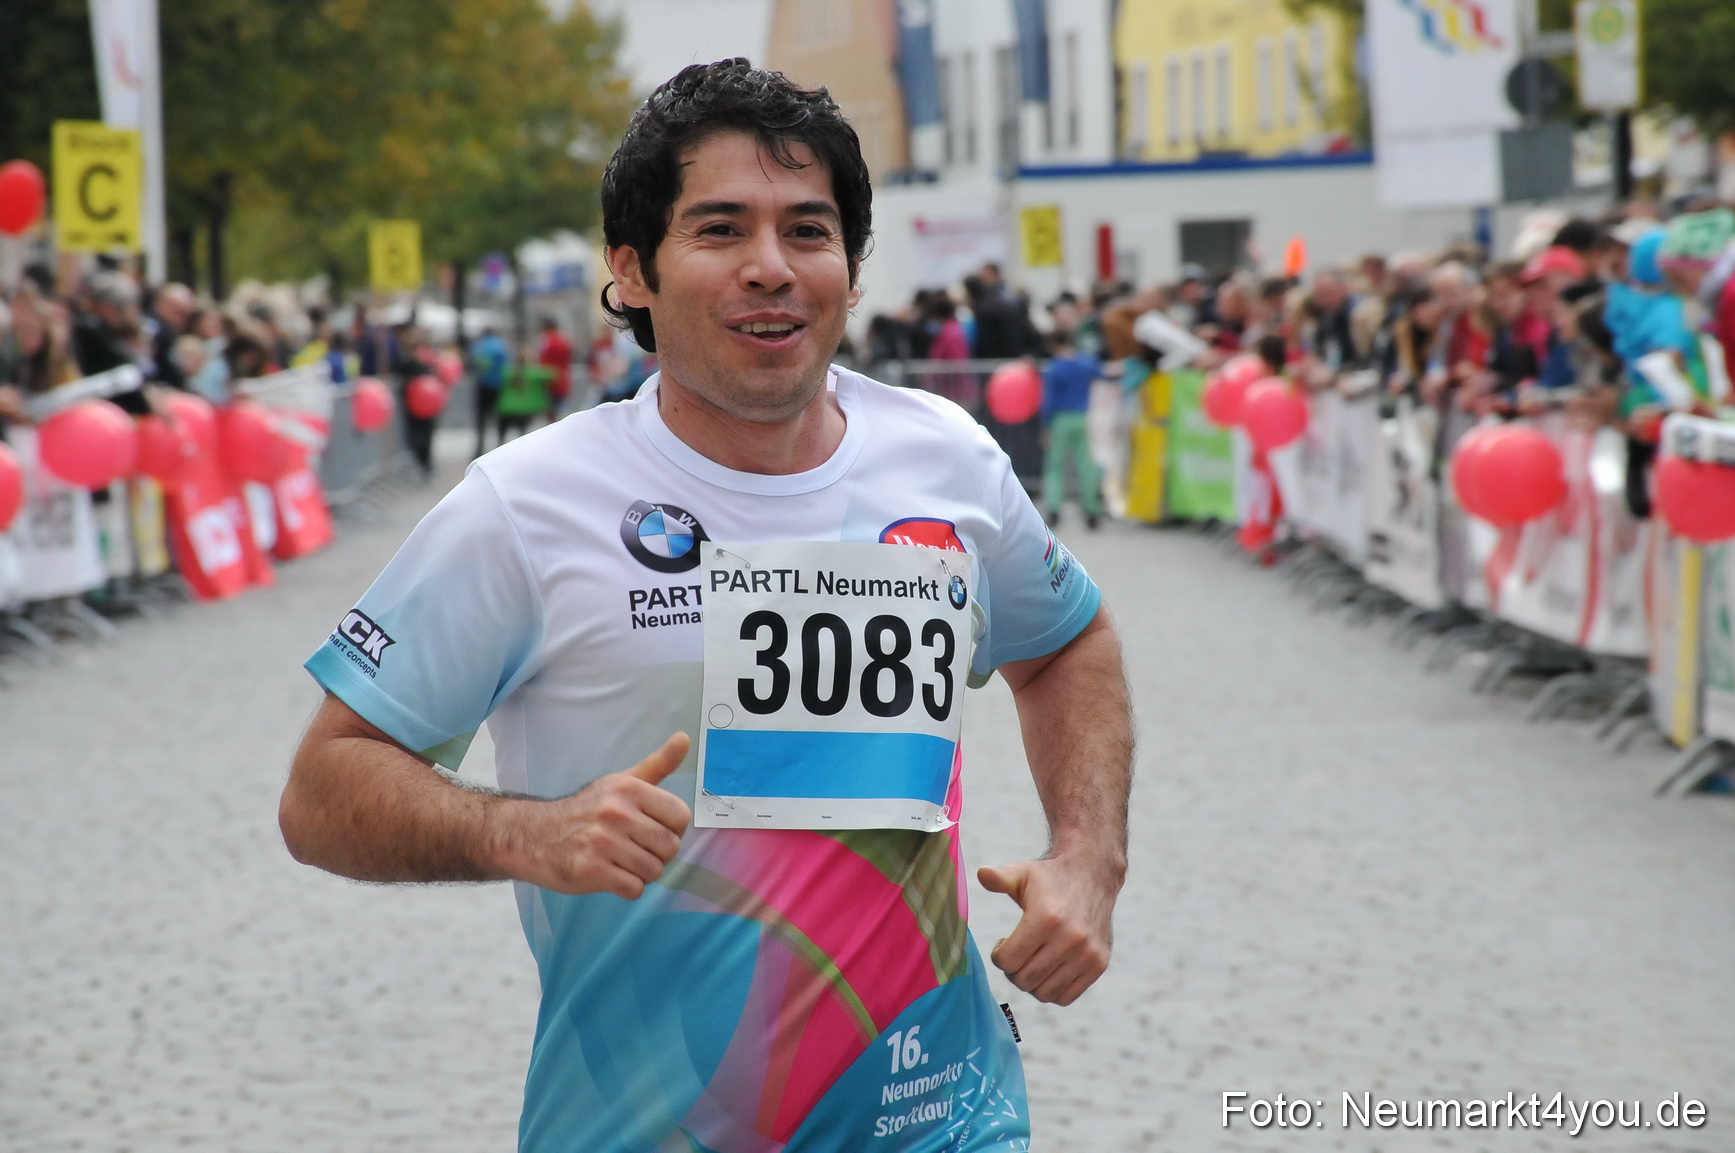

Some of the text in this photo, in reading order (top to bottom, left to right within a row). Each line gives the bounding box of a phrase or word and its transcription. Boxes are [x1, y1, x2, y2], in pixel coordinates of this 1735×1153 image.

[78, 162, 119, 221] C
[629, 585, 702, 612] PART
[711, 569, 940, 601] PARTL Neumarkt
[339, 609, 393, 665] CK
[631, 611, 703, 630] Neuma
[346, 650, 377, 679] concepts
[738, 610, 956, 721] 3083
[887, 1025, 929, 1074] 16.
[881, 1060, 965, 1106] Neumarkte
